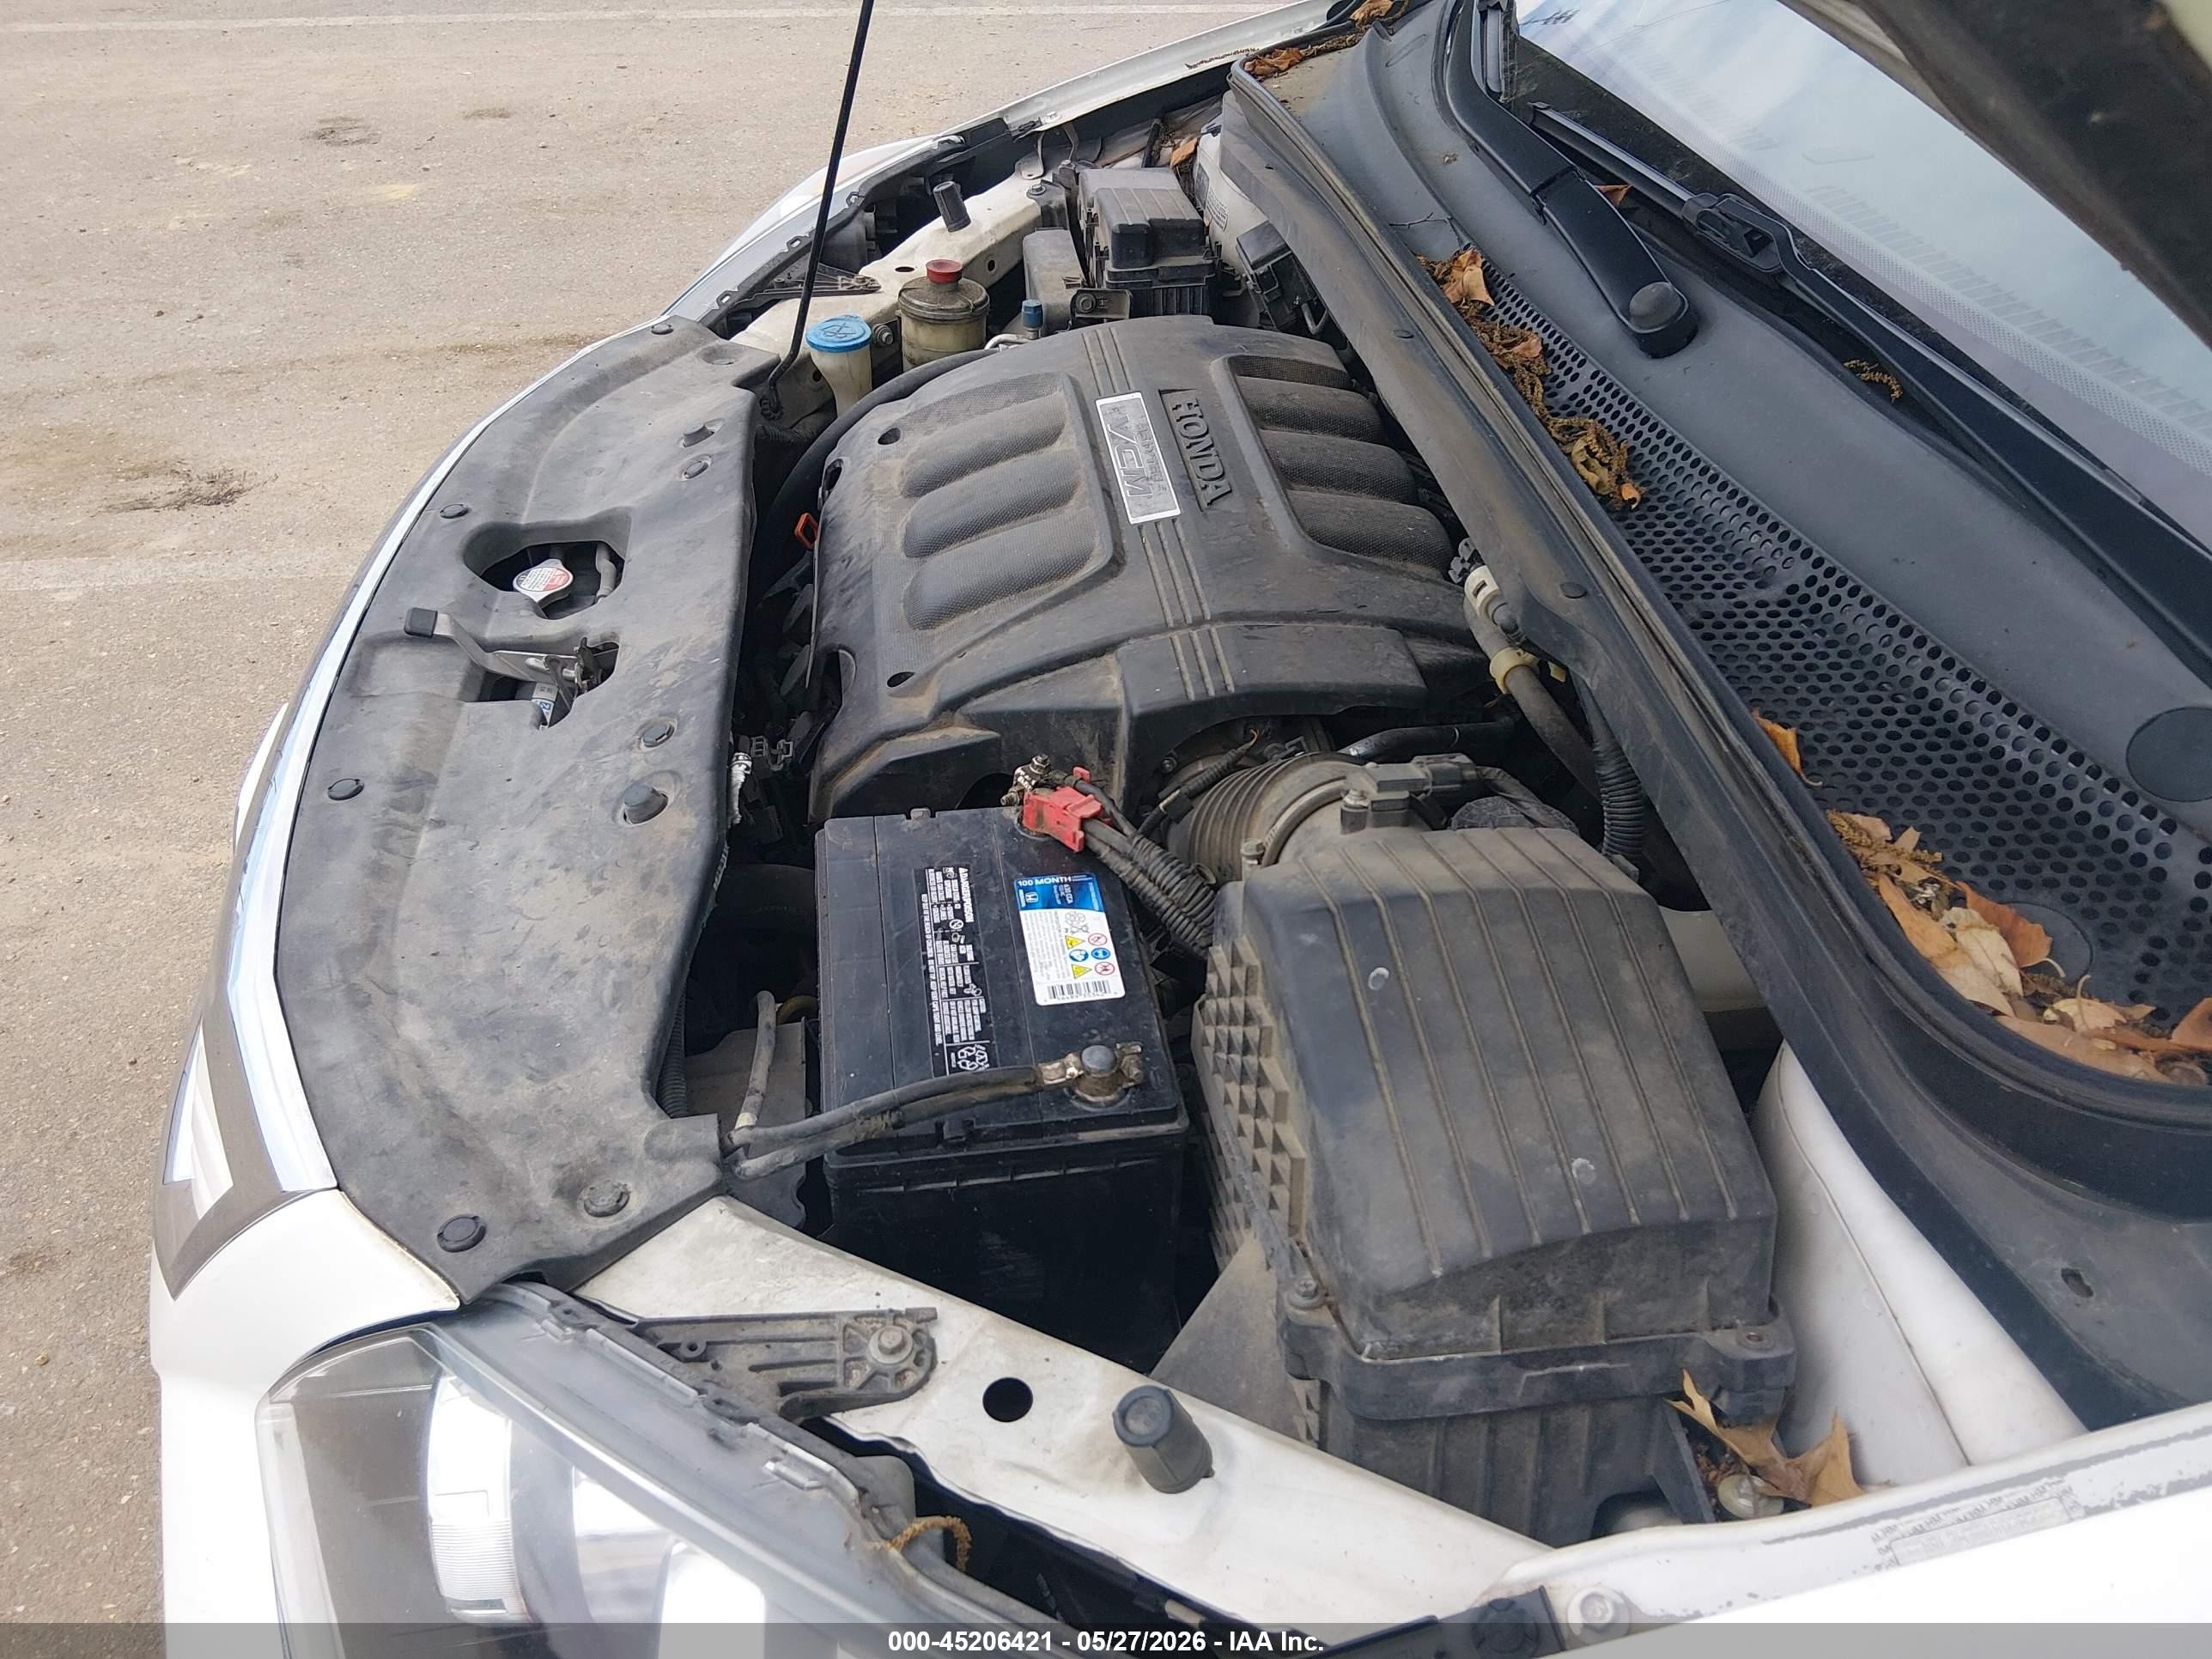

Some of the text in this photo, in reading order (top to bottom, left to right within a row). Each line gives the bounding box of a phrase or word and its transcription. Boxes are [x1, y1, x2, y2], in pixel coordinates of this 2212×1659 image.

[1107, 412, 1154, 497] VCM
[1171, 398, 1232, 507] HONDA
[1034, 876, 1072, 886] MONTH
